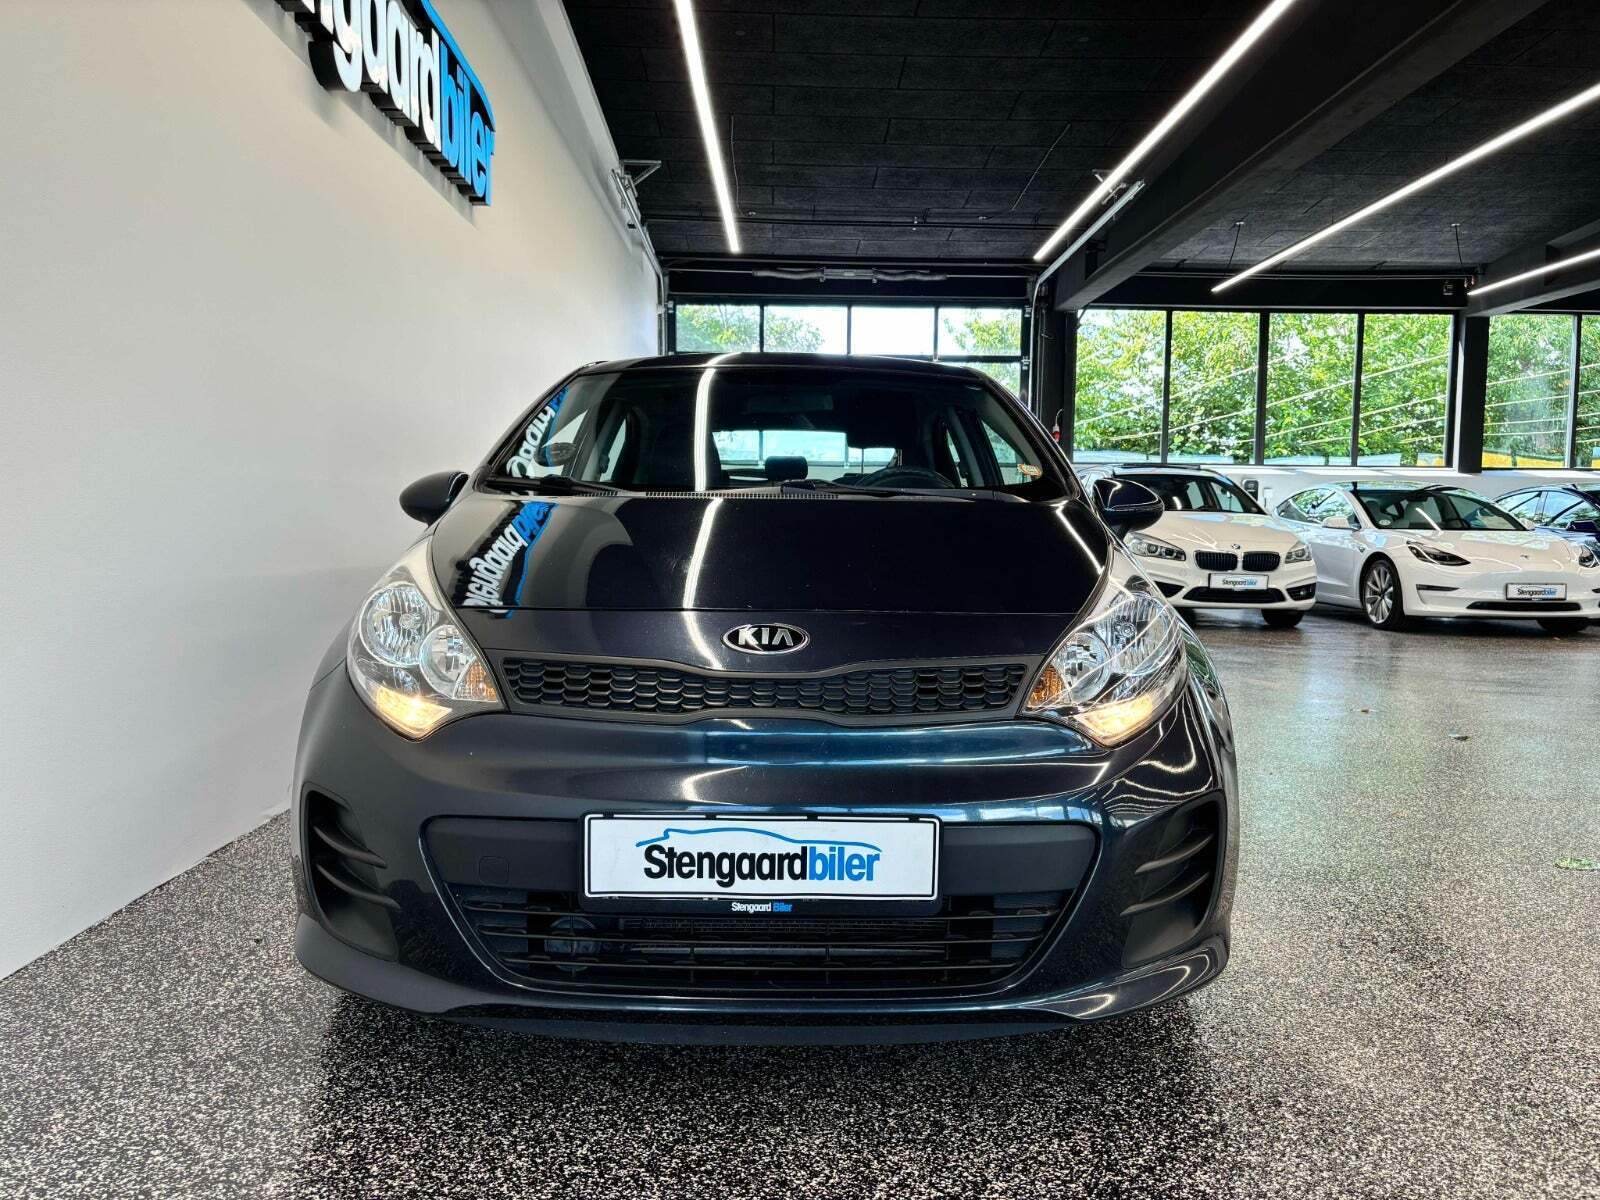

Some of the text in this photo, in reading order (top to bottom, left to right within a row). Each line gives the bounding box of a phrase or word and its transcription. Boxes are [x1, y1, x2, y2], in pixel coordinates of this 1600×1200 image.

[300, 0, 496, 206] gaardbiler
[737, 627, 794, 647] KIA
[643, 844, 881, 888] Stengaardbiler
[731, 902, 793, 914] Stengaard Biler
